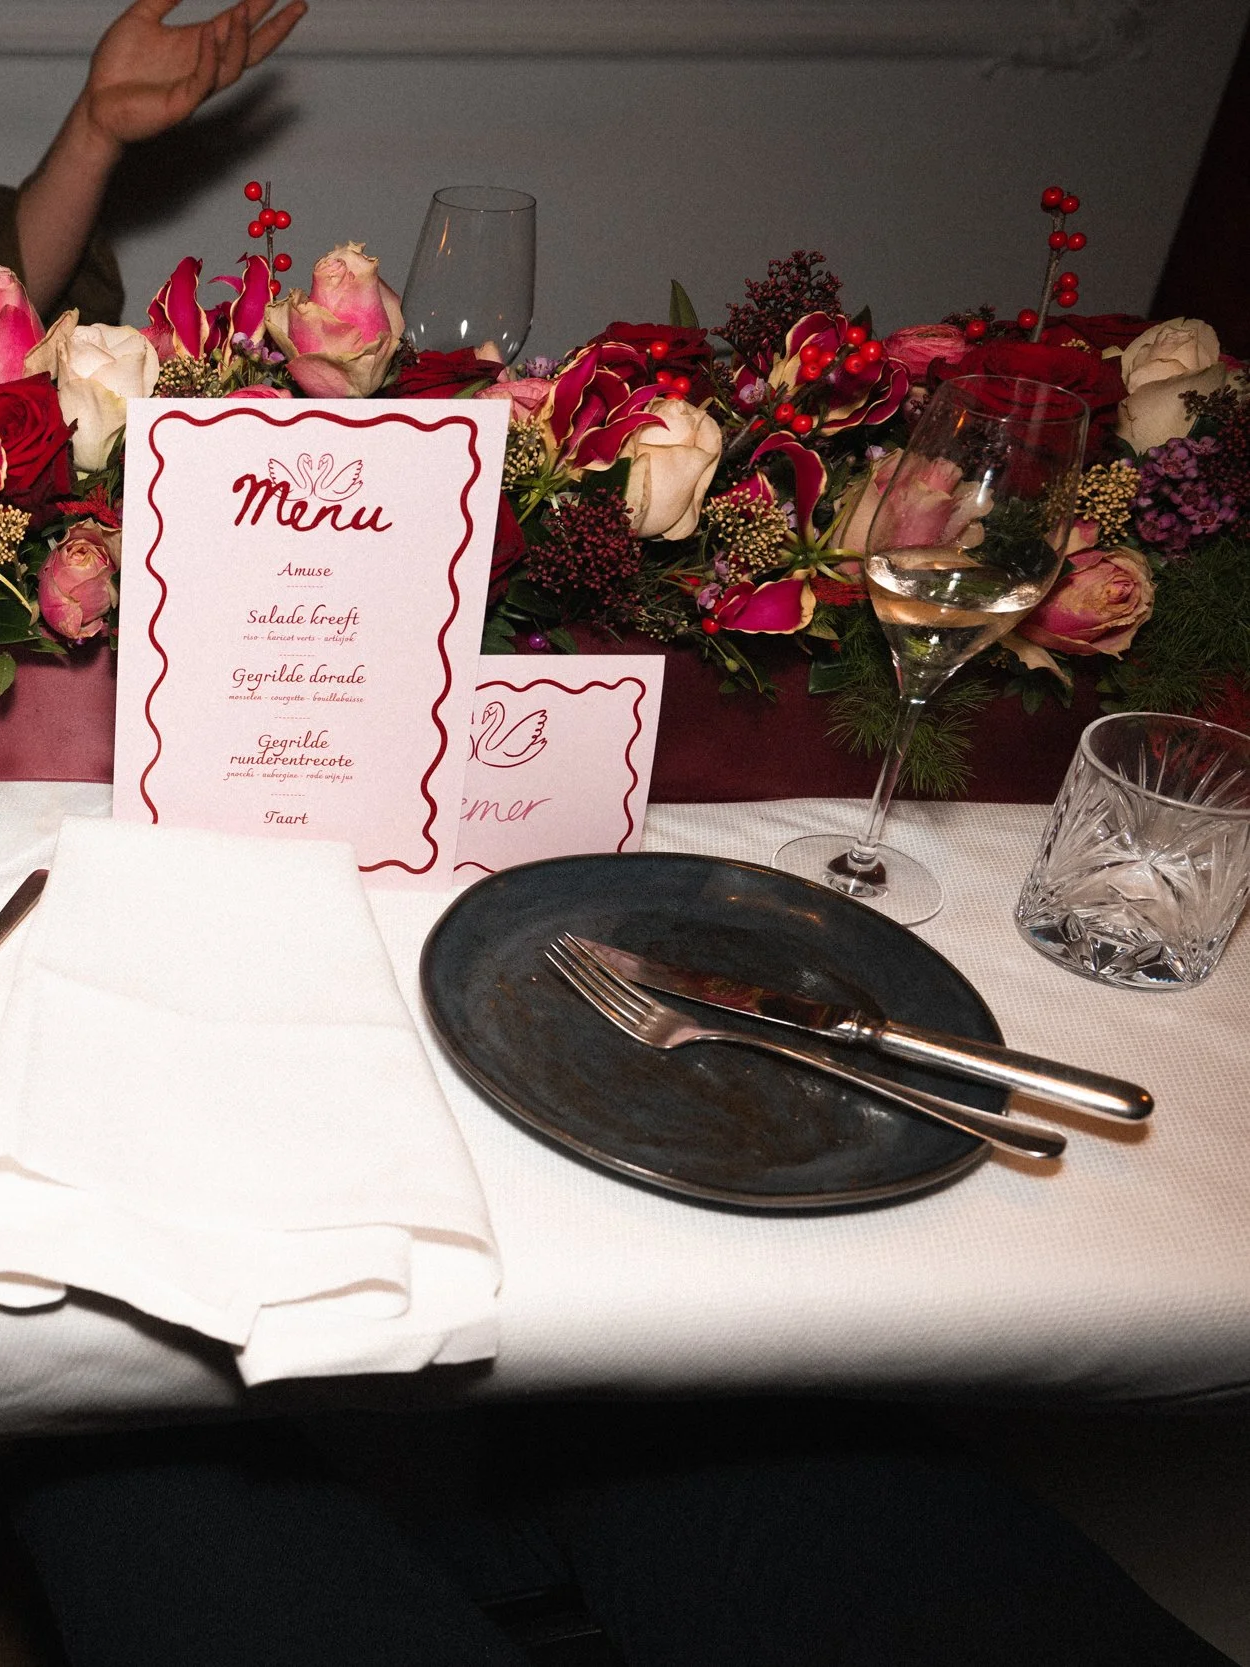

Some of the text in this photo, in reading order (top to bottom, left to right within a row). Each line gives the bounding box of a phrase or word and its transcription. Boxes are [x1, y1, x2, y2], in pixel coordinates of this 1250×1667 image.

[232, 473, 393, 532] Menu
[277, 562, 333, 577] Amuse
[247, 604, 360, 635] Salade kreeft
[267, 631, 294, 641] haricot
[324, 632, 357, 645] artisjok
[232, 663, 366, 691] Gegrilde dorade
[228, 691, 262, 701] mosselen
[271, 694, 305, 705] courgette
[313, 692, 364, 703] bouillabaisse
[258, 730, 330, 756] Gegrilde
[230, 747, 355, 767] runderentrecote
[223, 768, 254, 780] gnocchi
[262, 769, 298, 782] aubergine
[306, 770, 323, 779] rode
[325, 774, 341, 783] wijn
[263, 810, 309, 825] Taart
